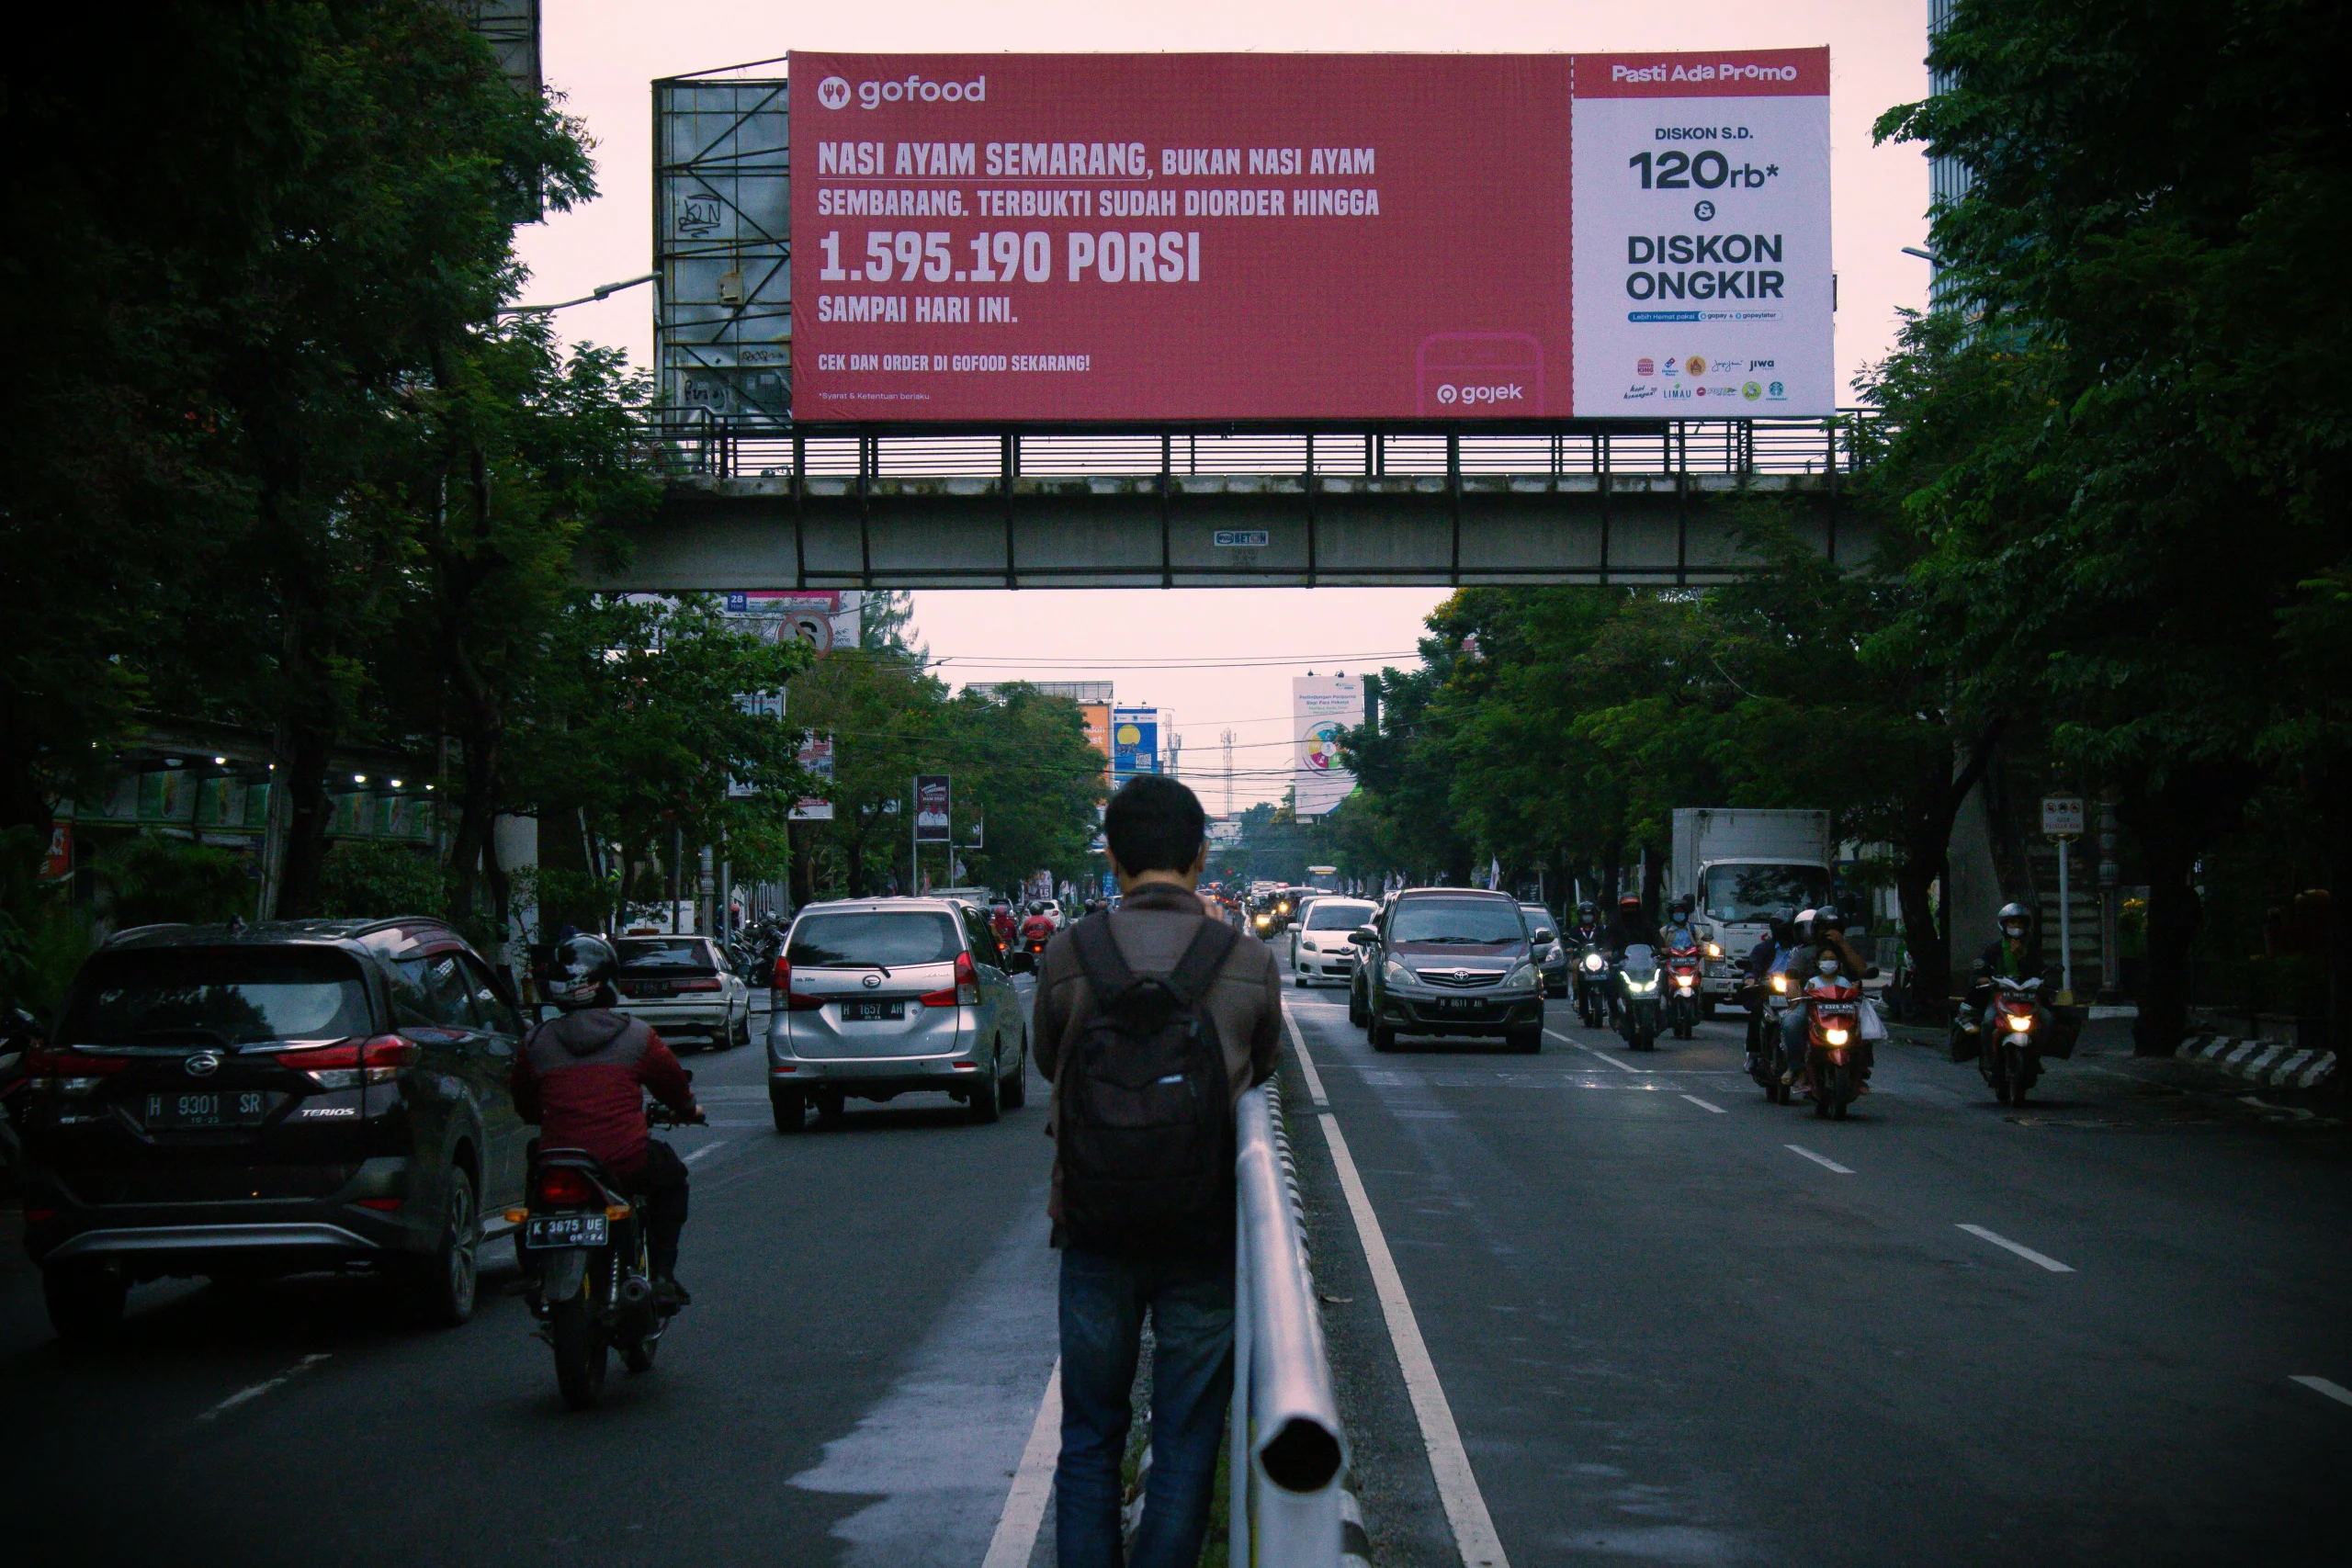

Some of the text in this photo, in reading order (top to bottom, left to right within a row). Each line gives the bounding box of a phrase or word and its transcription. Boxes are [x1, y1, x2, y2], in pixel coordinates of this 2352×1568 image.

[1612, 63, 1797, 84] Pasti Ada Promo
[859, 74, 986, 110] gofood
[1655, 127, 1754, 141] DISKON S.D.
[819, 142, 1375, 179] NASI AYAM SEMARANG, BUKAN NASI AYAM
[819, 188, 1380, 217] SEMBARANG. TERBUKTI SUDAH DIORDER HINGGA
[820, 231, 1200, 283] 1.595.190 PORSI
[1628, 233, 1782, 265] DISKON
[1625, 269, 1784, 300] ONGKIR
[818, 295, 1018, 323] SAMPAI HARI INI.
[1633, 312, 1652, 321] Lebih
[1742, 311, 1777, 320] gopaylater
[818, 354, 1091, 372] CEK DAN ORDER DI GOFOOD SEKARANG!
[857, 392, 898, 400] Ketentuan
[899, 392, 930, 400] berlaku
[1461, 383, 1523, 405] gojek
[1663, 389, 1691, 399] LIMAU
[1235, 532, 1266, 543] BETON
[730, 594, 743, 604] 28
[843, 1003, 903, 1016] H 1657 AH
[150, 1093, 261, 1116] H 9301 SR
[301, 1107, 356, 1117] TERIOS
[533, 1222, 542, 1235] K
[586, 1218, 603, 1231] UE
